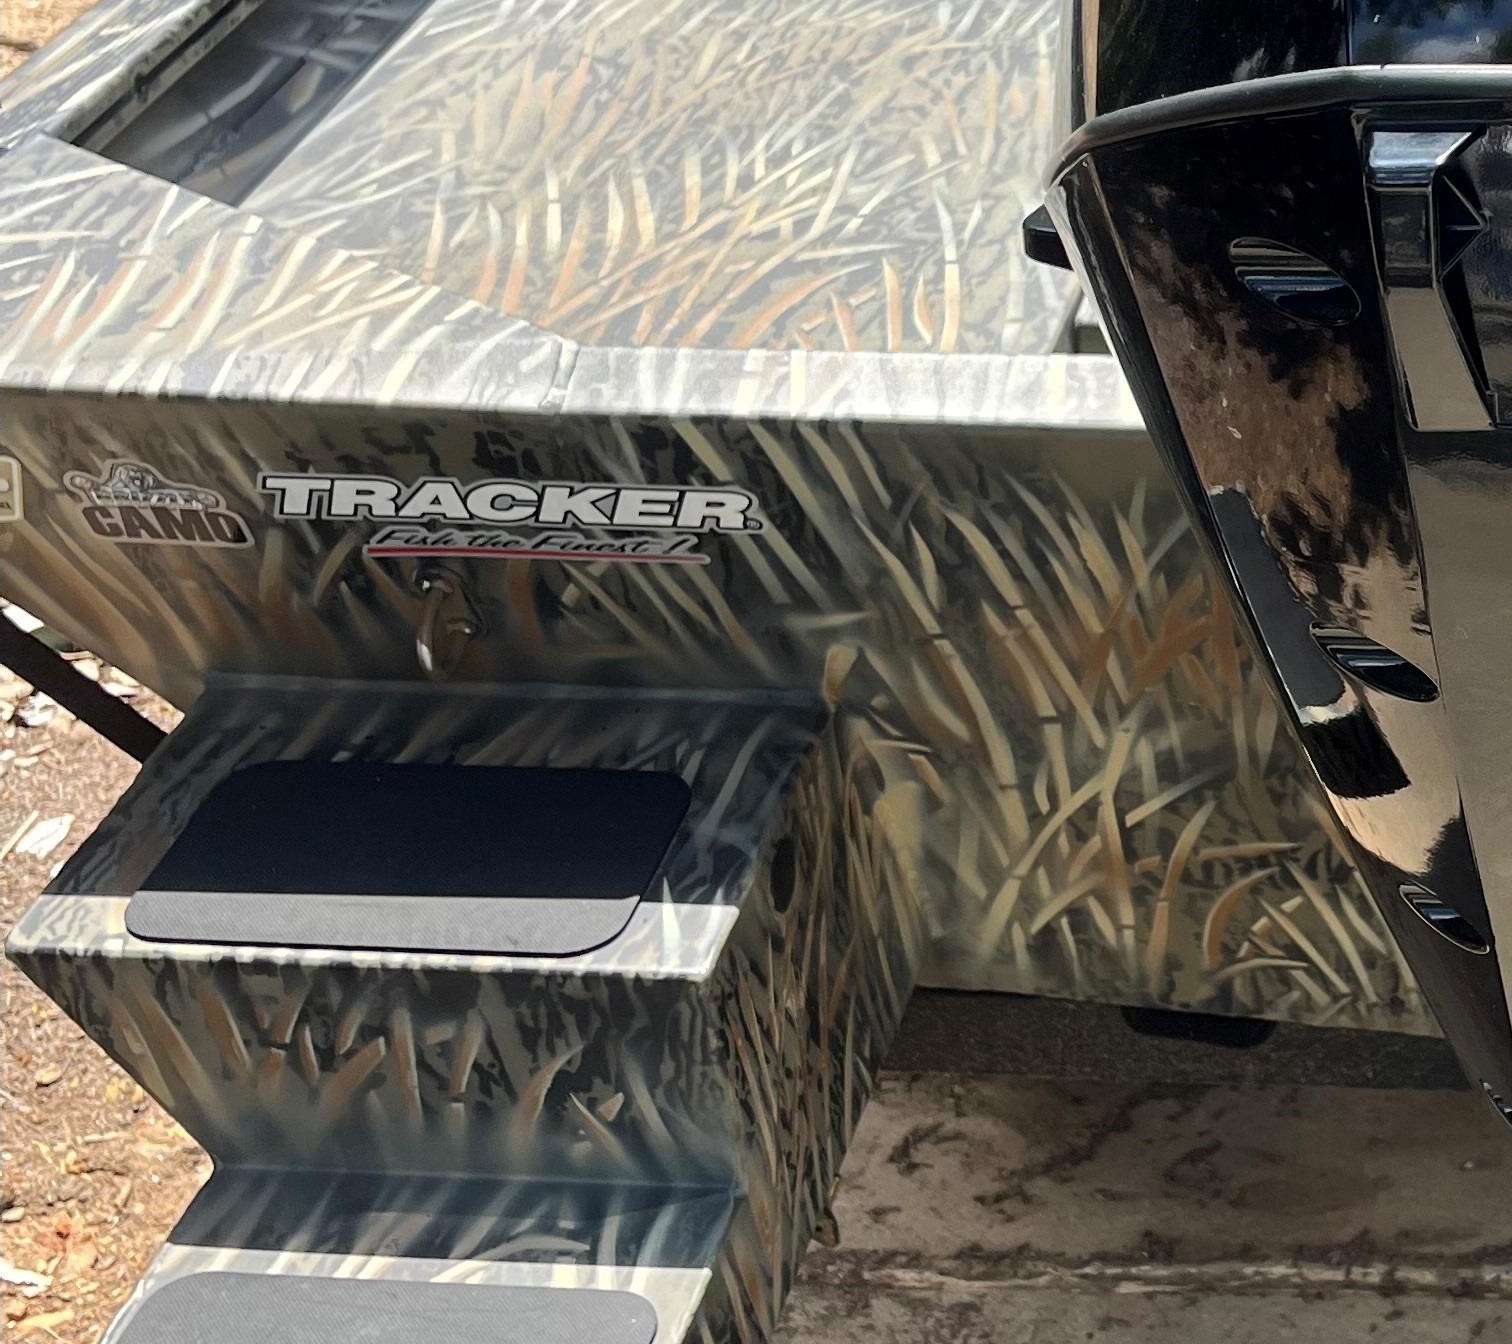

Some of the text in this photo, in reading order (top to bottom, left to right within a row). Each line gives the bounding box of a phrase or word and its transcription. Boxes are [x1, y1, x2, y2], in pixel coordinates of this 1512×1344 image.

[261, 475, 754, 529] TRACKER
[81, 505, 248, 543] CAMO
[375, 527, 458, 547] Fish
[465, 530, 522, 550] the
